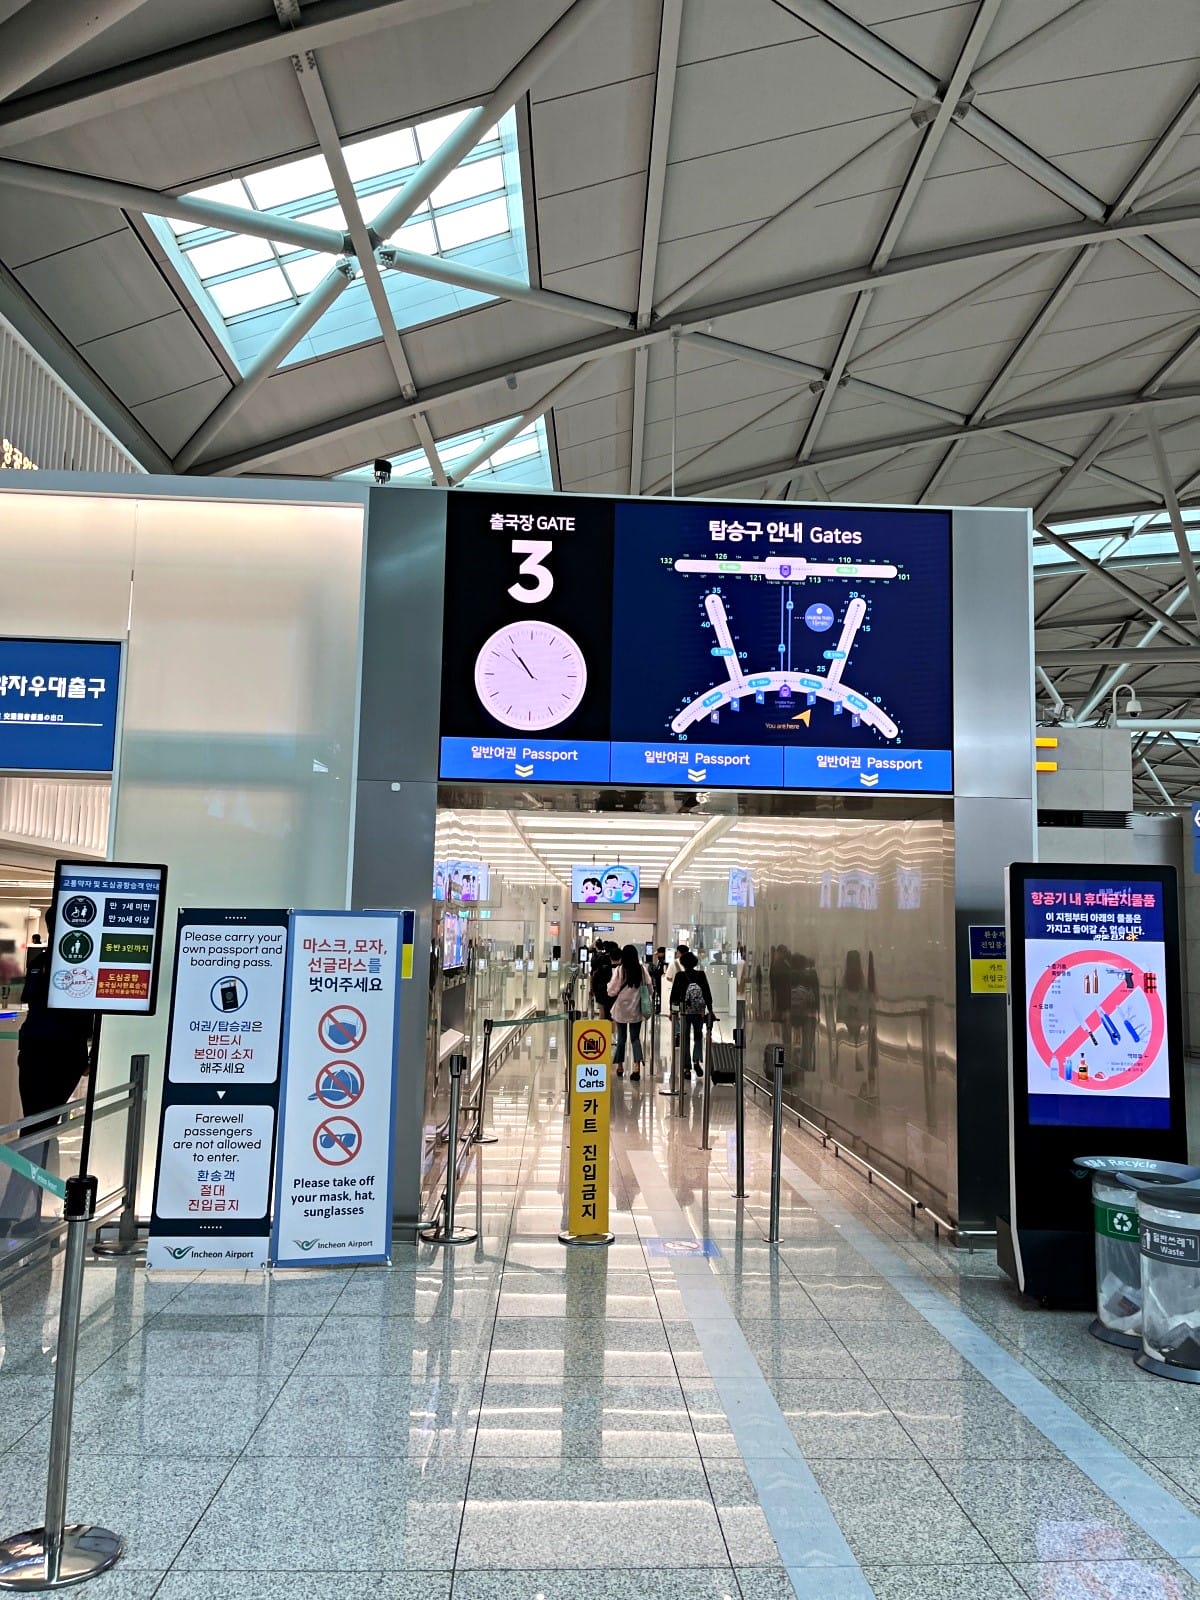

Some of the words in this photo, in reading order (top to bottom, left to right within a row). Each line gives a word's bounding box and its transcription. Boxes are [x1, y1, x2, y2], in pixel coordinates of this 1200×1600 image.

[489, 512, 535, 532] 출국장
[536, 516, 576, 531] GATE
[709, 519, 764, 542] 탑승구
[766, 521, 803, 543] 안내
[809, 527, 863, 544] Gates
[507, 539, 554, 604] 3
[471, 746, 517, 760] 일반여권
[522, 748, 578, 762] Passport
[644, 751, 689, 764] 일반여권
[695, 752, 751, 767] Passport
[816, 755, 861, 769] 일반여권
[867, 757, 923, 772] Passport
[1031, 892, 1067, 906] 항공기
[1070, 892, 1082, 906] 내
[109, 902, 117, 910] 만
[135, 903, 150, 911] 미만
[108, 915, 116, 923] 만
[117, 915, 133, 923] 70세
[134, 916, 150, 924] 이상
[1045, 912, 1054, 922] 이
[1056, 912, 1089, 923] 지점부터
[1090, 913, 1115, 923] 아래의
[1117, 913, 1142, 924] 물품은
[1046, 924, 1071, 934] 가지고
[1073, 924, 1098, 934] 들어갈
[1099, 925, 1108, 934] 수
[1109, 925, 1145, 936] 없습니다.
[185, 932, 222, 942] Please
[224, 934, 255, 944] carry
[257, 933, 283, 943] your
[182, 946, 206, 955] own
[208, 946, 259, 956] passport
[261, 945, 283, 955] and
[303, 938, 352, 954] 마스크,
[354, 939, 388, 955] 모자,
[190, 957, 241, 969] boarding
[243, 958, 273, 968] pass.
[308, 958, 382, 974] 선글라스를
[309, 977, 383, 993] 벗어주세요
[189, 1021, 263, 1033] 여권/탑승권은
[208, 1035, 242, 1047] 반드시
[193, 1048, 228, 1060] 본인이
[231, 1048, 254, 1060] 소지
[200, 1063, 245, 1075] 해주세요
[585, 1067, 599, 1077] No
[579, 1079, 605, 1088] Carts
[195, 1113, 244, 1124] Farewell
[583, 1099, 598, 1133] 카트
[184, 1127, 253, 1139] passengers
[173, 1141, 193, 1150] are
[195, 1140, 215, 1149] not
[217, 1139, 262, 1150] allowed
[193, 1153, 205, 1162] to
[207, 1153, 240, 1163] enter.
[1109, 1159, 1158, 1169] Recycle
[197, 1169, 235, 1182] 환송객
[293, 1178, 330, 1189] Please
[332, 1177, 357, 1187] take
[359, 1175, 376, 1186] off
[581, 1144, 598, 1220] 진입금지
[200, 1184, 225, 1197] 절대
[291, 1193, 317, 1206] your
[319, 1191, 352, 1203] mask,
[354, 1189, 376, 1202] hat,
[188, 1199, 239, 1212] 진입금지
[304, 1205, 364, 1219] sunglasses
[317, 1241, 346, 1249] Incheon
[348, 1240, 373, 1249] Airport
[191, 1250, 223, 1259] Incheon
[225, 1250, 254, 1260] Airport
[1160, 1245, 1185, 1257] Waste
